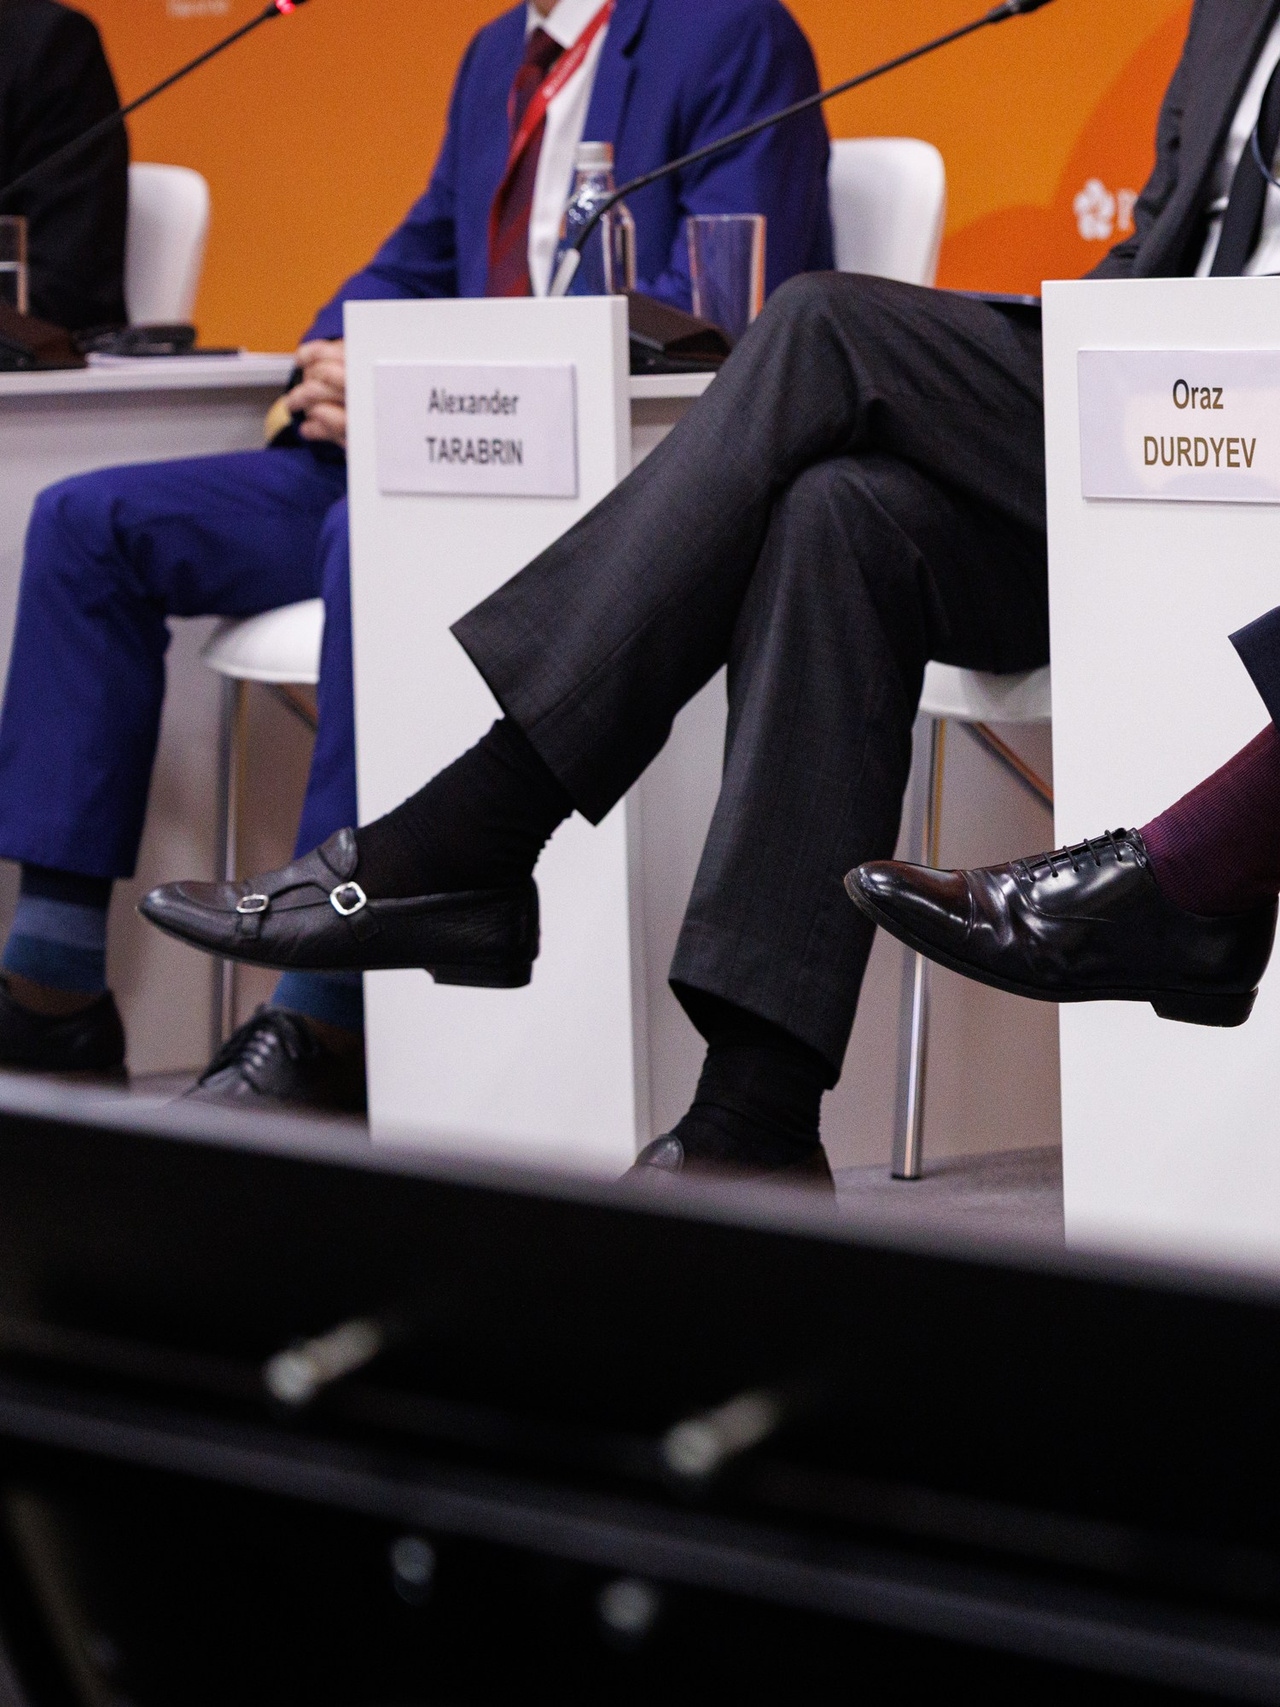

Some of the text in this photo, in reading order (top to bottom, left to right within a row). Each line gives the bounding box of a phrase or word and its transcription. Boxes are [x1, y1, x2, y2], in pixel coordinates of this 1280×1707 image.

[428, 387, 519, 415] Alexander
[1172, 378, 1224, 410] Oraz
[426, 437, 523, 464] TARABRIN
[1144, 435, 1257, 468] DURDYEV
